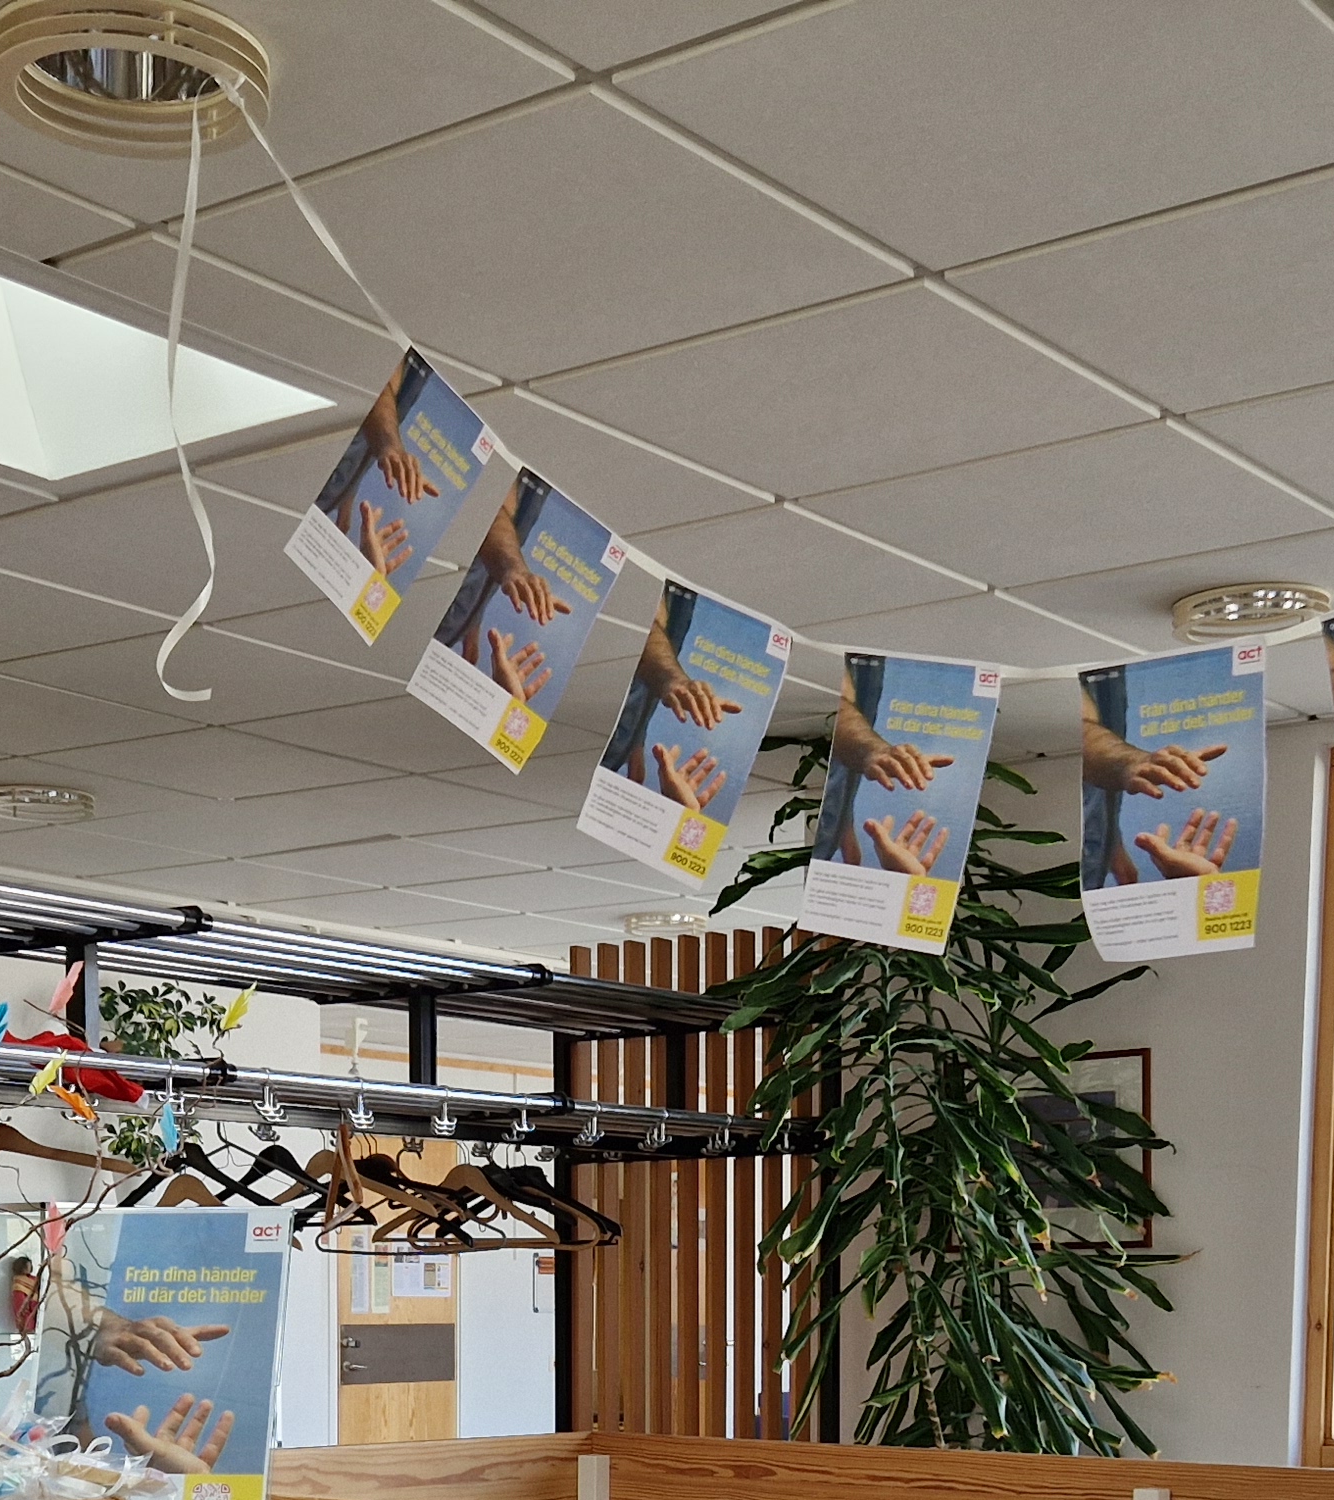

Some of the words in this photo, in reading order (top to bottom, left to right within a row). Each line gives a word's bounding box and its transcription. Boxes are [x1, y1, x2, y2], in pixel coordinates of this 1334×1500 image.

[772, 633, 789, 648] act
[1238, 645, 1262, 660] act
[979, 673, 998, 683] act
[670, 852, 688, 866] 900
[688, 860, 707, 876] 1223
[905, 923, 923, 934] 900
[924, 926, 944, 938] 1223
[1204, 923, 1226, 935] 900
[1230, 919, 1252, 932] 1223
[253, 1224, 282, 1237] act
[125, 1266, 159, 1283] Från
[163, 1266, 197, 1283] dina
[201, 1266, 257, 1283] händer
[123, 1287, 146, 1303] till
[149, 1287, 175, 1303] där
[178, 1287, 207, 1303] det
[210, 1287, 267, 1303] händer
